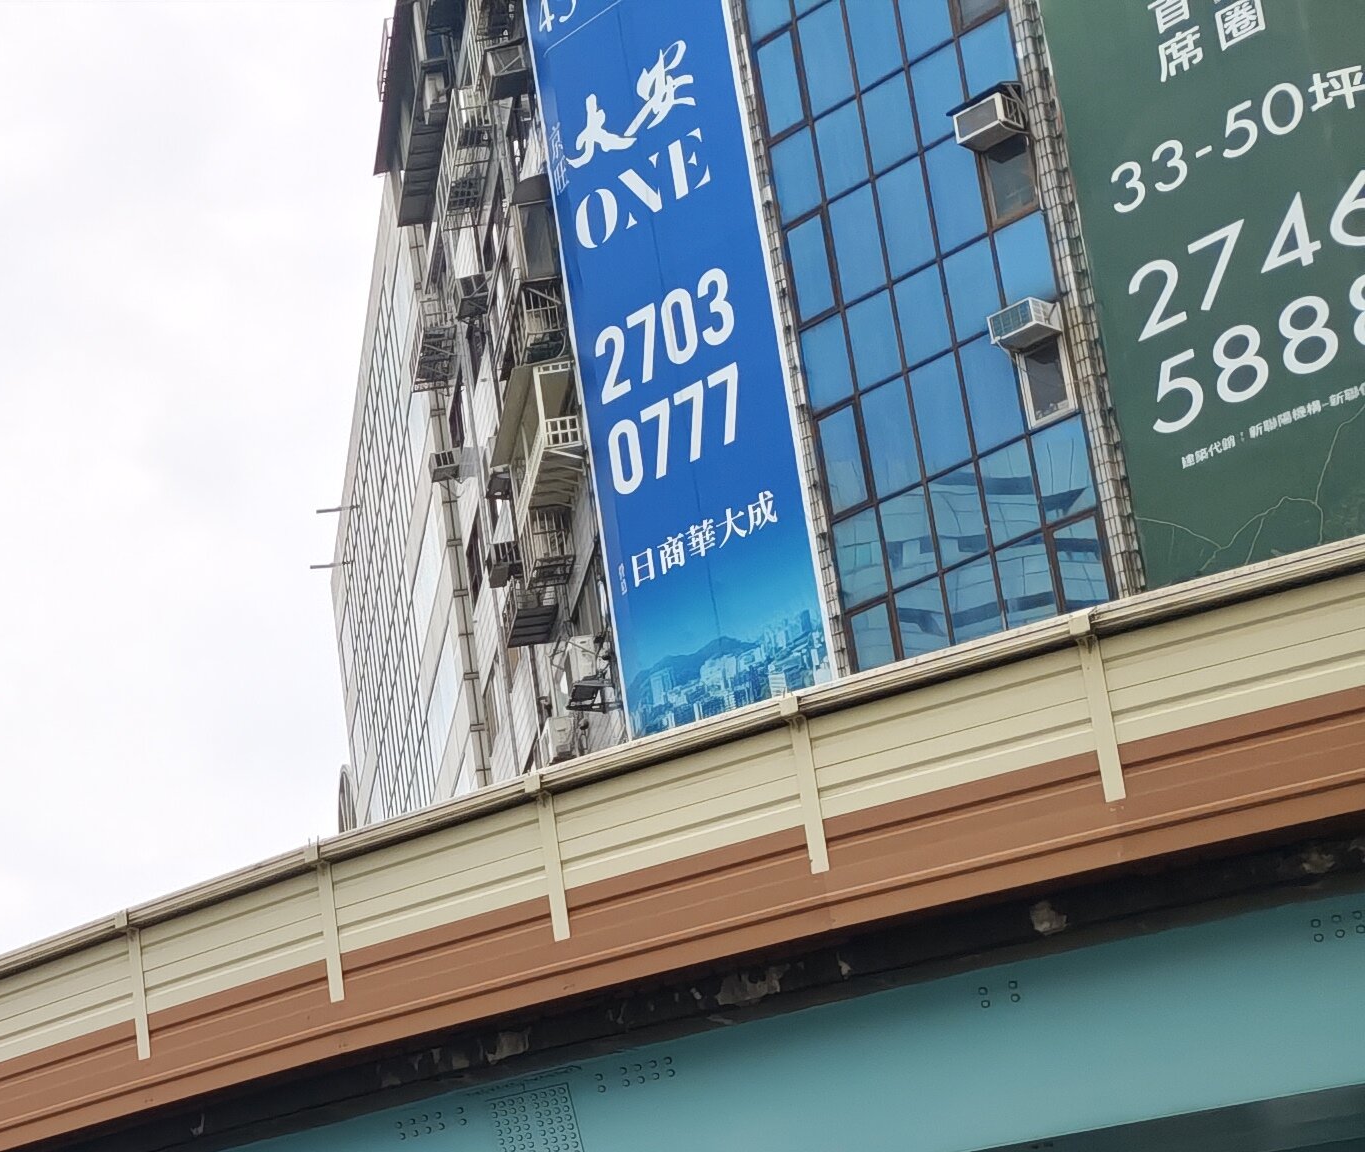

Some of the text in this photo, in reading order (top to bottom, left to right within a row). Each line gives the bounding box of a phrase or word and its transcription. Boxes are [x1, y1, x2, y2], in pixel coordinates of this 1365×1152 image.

[565, 39, 696, 169] 大安
[1110, 65, 1365, 214] 33-50坪
[575, 127, 711, 249] ONE
[595, 267, 736, 406] 2703
[608, 362, 741, 496] 0777
[631, 490, 778, 588] 日商華大成
